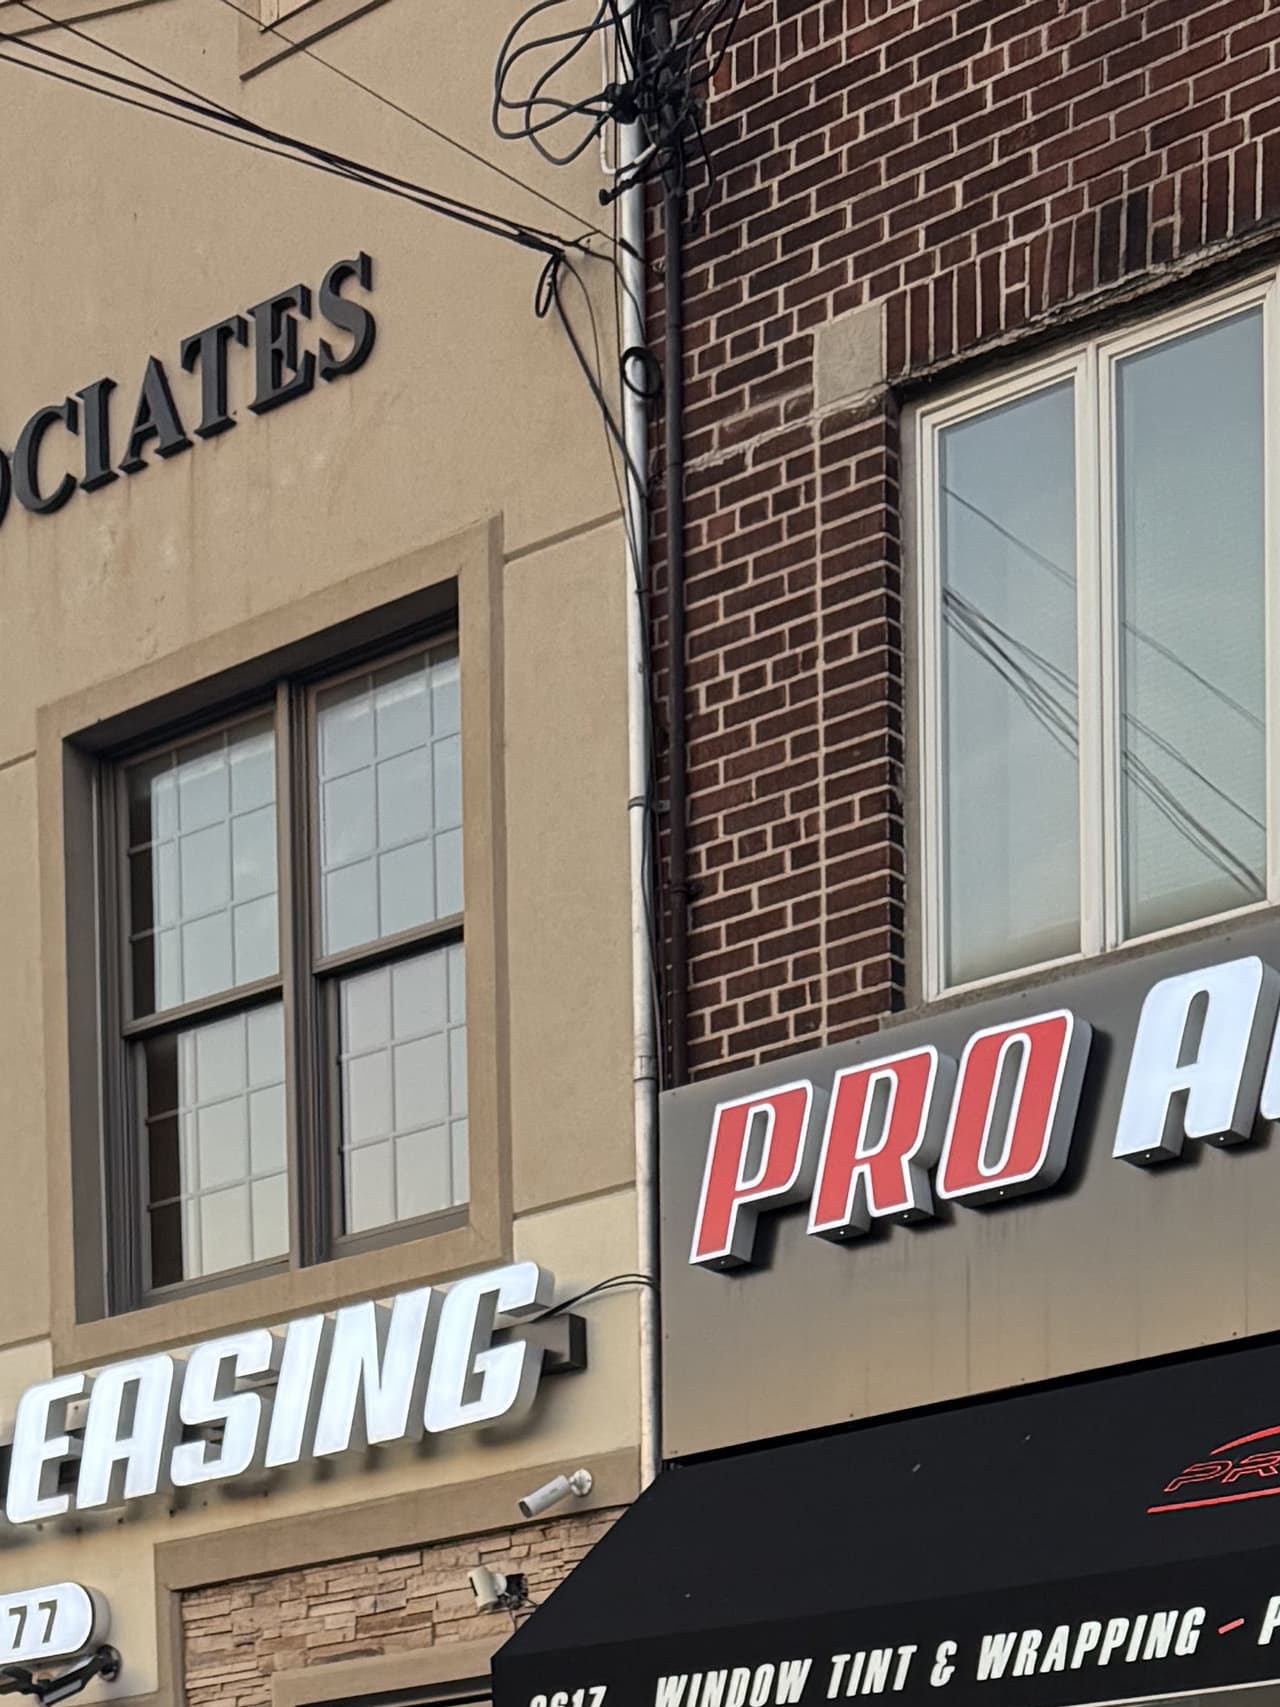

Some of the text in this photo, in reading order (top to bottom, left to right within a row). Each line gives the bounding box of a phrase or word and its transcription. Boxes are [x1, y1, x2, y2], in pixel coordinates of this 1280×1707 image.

[689, 1008, 1084, 1268] PRO
[829, 1645, 918, 1700] TINT
[930, 1641, 959, 1687] &
[976, 1607, 1208, 1681] WRAPPING
